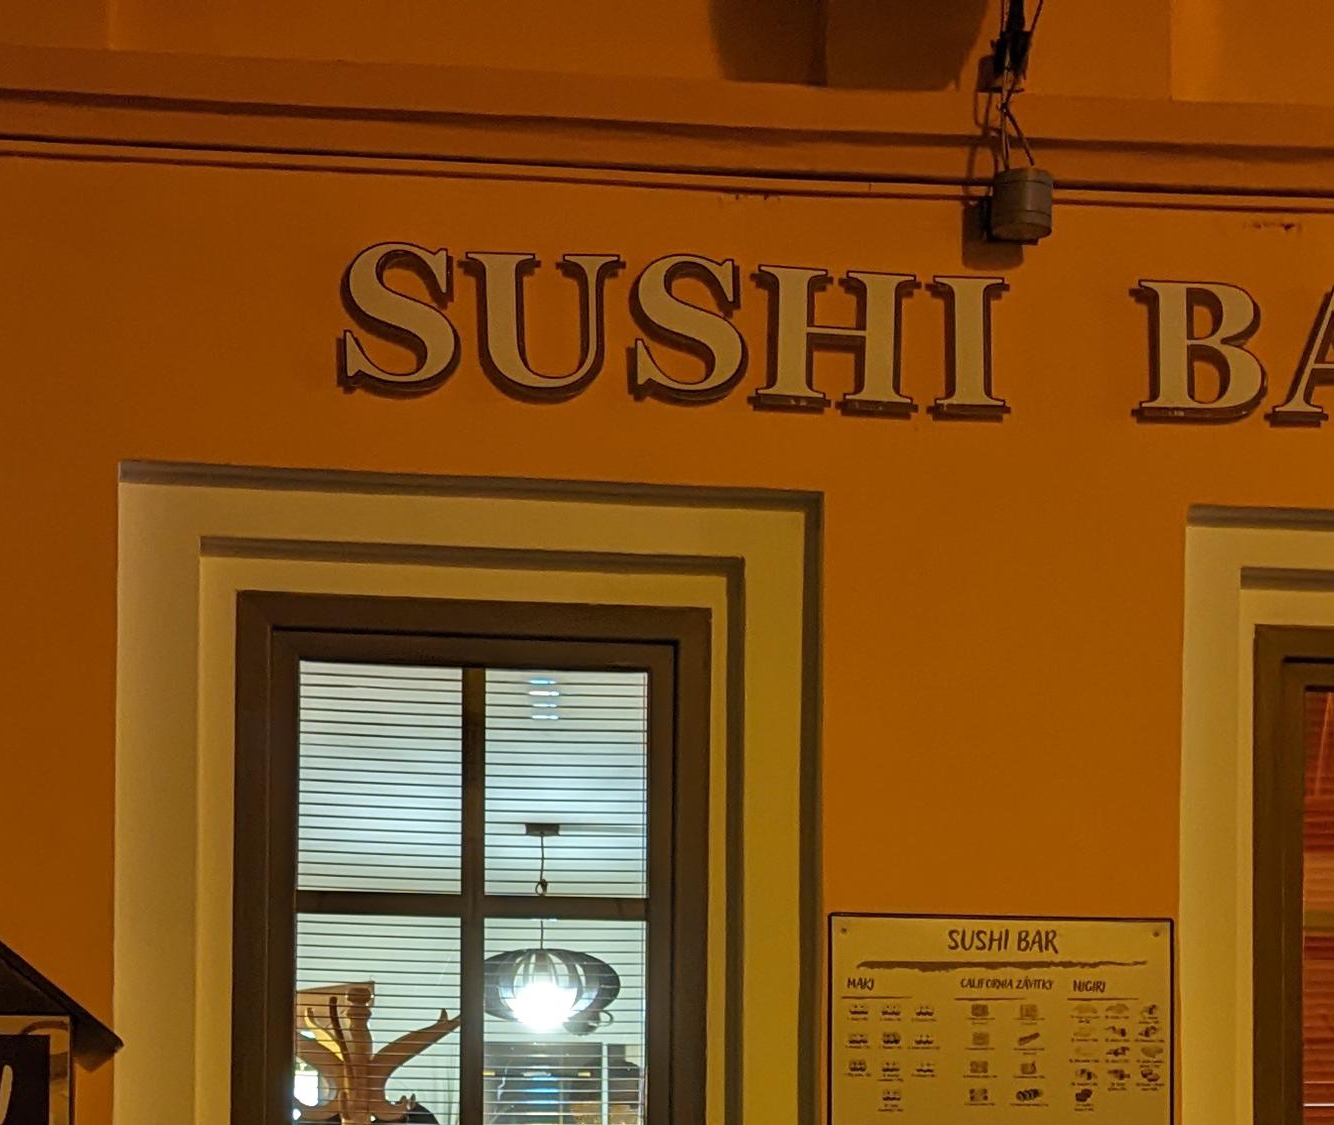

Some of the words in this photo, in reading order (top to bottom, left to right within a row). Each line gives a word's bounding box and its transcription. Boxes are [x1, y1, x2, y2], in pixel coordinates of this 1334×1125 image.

[341, 241, 1009, 410] SUSHI
[947, 928, 1010, 952] SUSHI
[1017, 928, 1059, 955] BAR
[846, 977, 875, 991] MAKI
[960, 977, 1014, 990] CALIFORNIA
[1015, 975, 1055, 990] ZÁVITKY
[1072, 980, 1107, 993] NIGIRI
